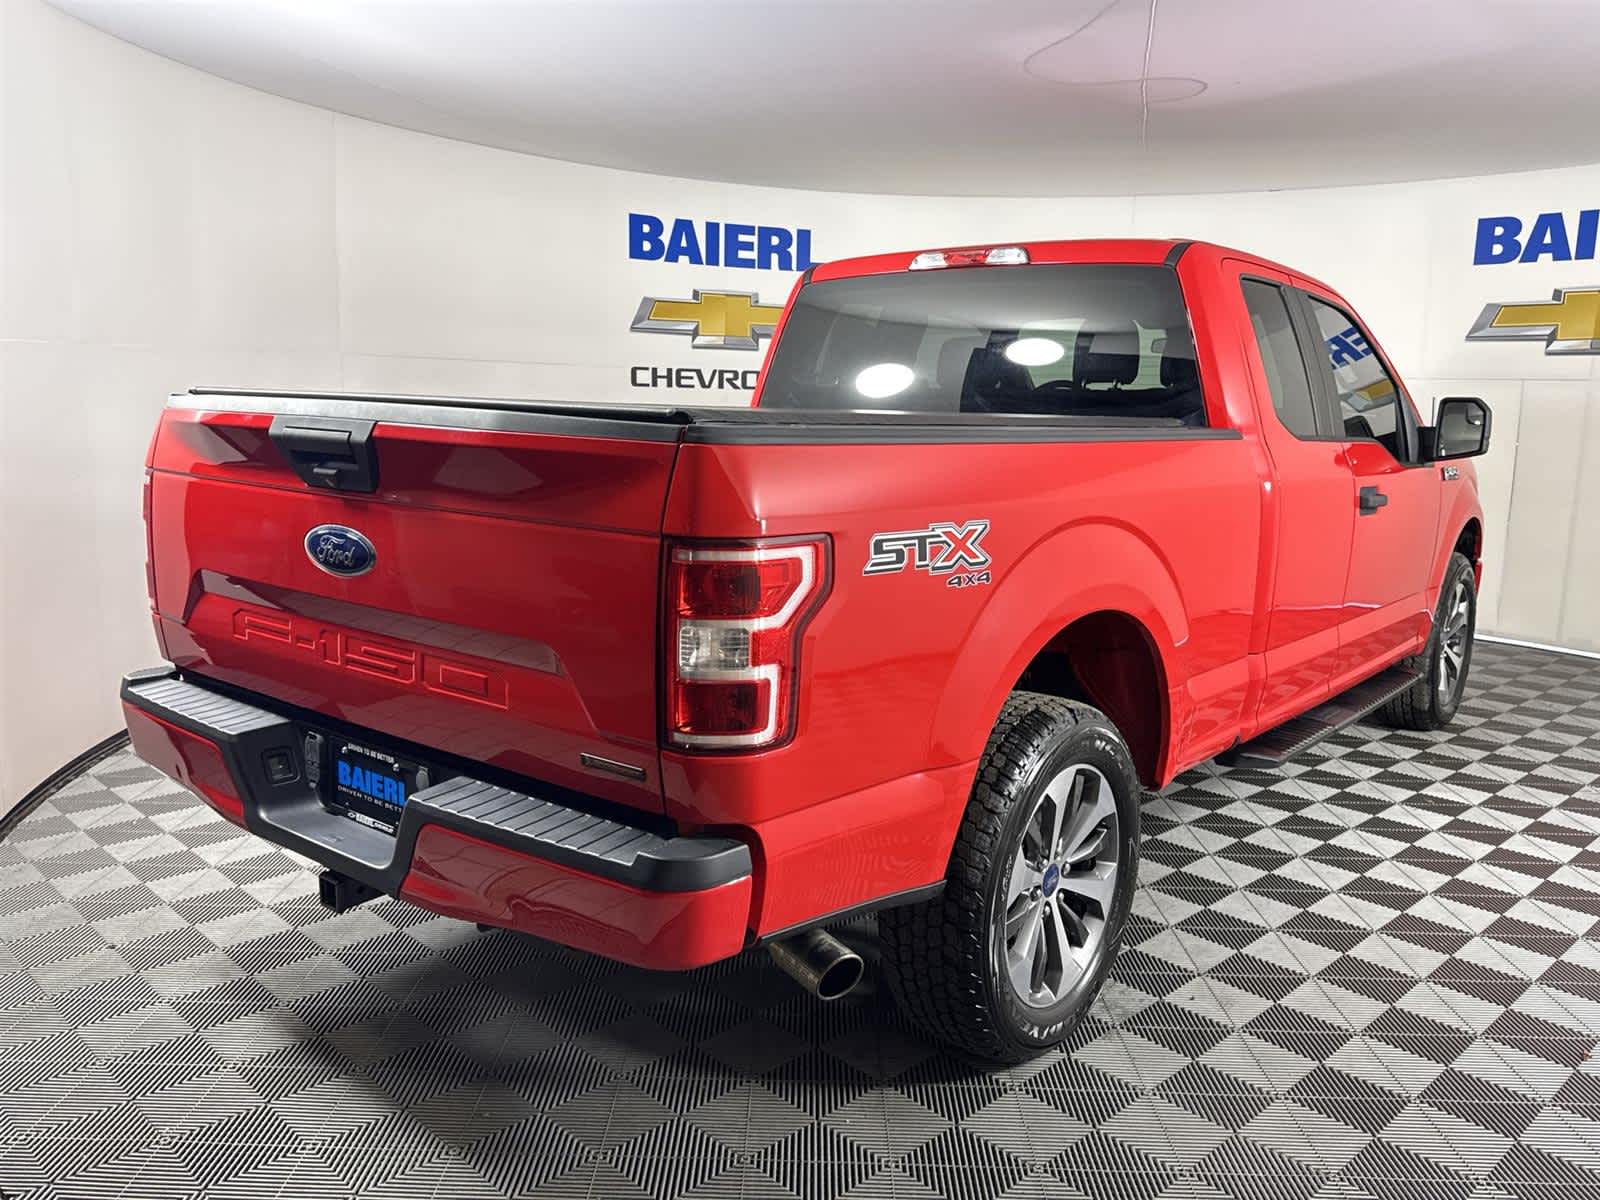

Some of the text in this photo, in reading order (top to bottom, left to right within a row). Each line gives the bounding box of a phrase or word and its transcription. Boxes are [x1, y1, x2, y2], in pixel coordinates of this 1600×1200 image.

[862, 520, 992, 576] STX
[232, 607, 509, 711] F-150
[337, 785, 362, 798] DRIVEN
[364, 795, 373, 803] TO
